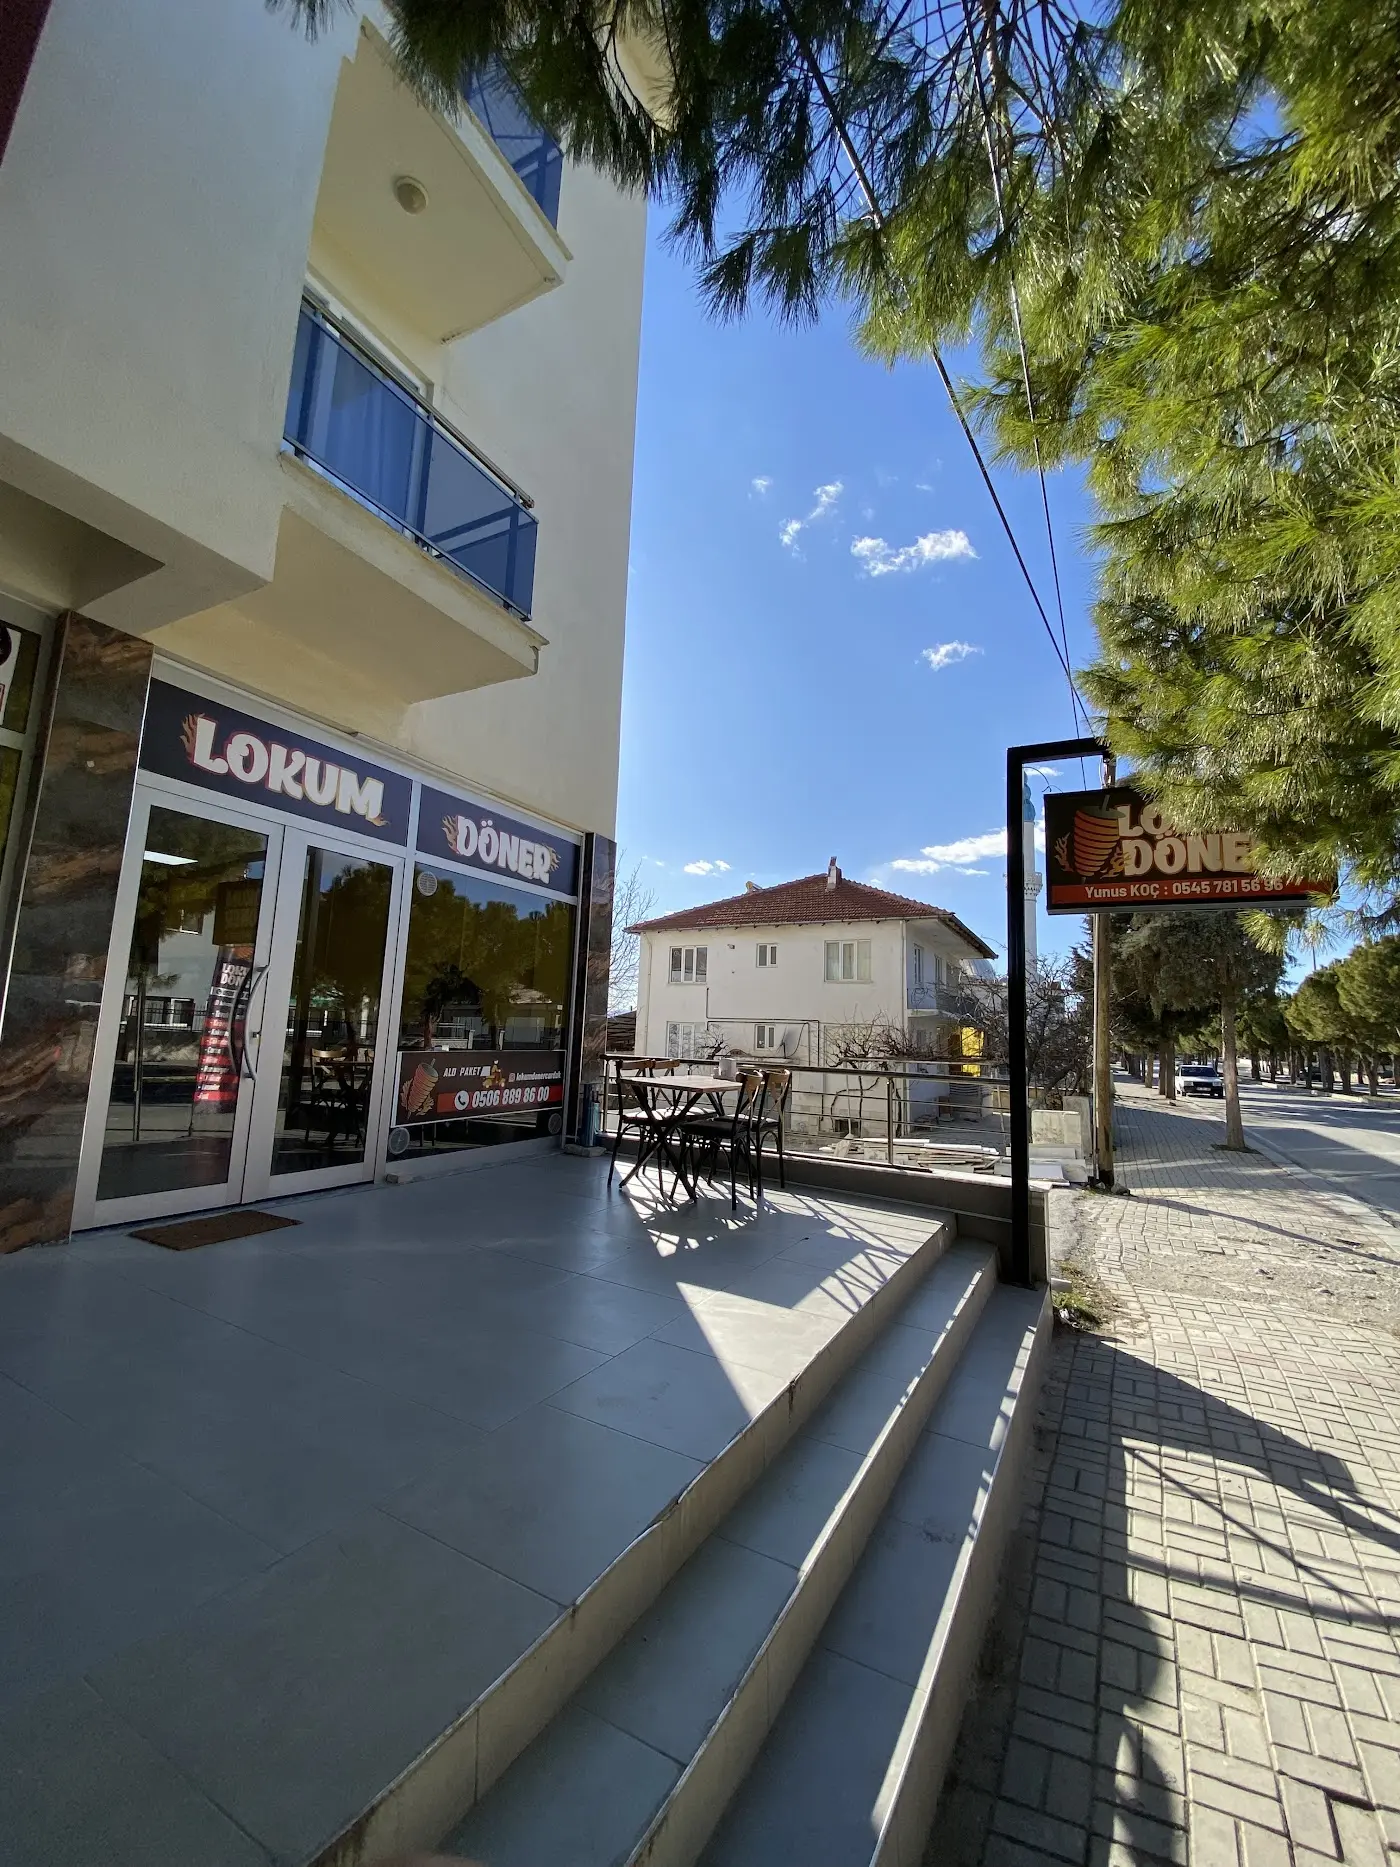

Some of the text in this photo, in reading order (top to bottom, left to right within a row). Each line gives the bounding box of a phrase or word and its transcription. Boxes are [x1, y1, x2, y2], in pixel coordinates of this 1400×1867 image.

[192, 715, 385, 822] LOKUM
[455, 816, 551, 884] DÖNER
[1122, 833, 1255, 876] DÖNE
[1084, 885, 1128, 898] Yunus
[1130, 883, 1160, 898] KOÇ
[1172, 881, 1210, 896] 0545
[1213, 880, 1238, 893] 781
[1242, 879, 1261, 892] 56
[459, 1066, 482, 1077] PAKET
[472, 1085, 550, 1108] 0506 889 86 00
